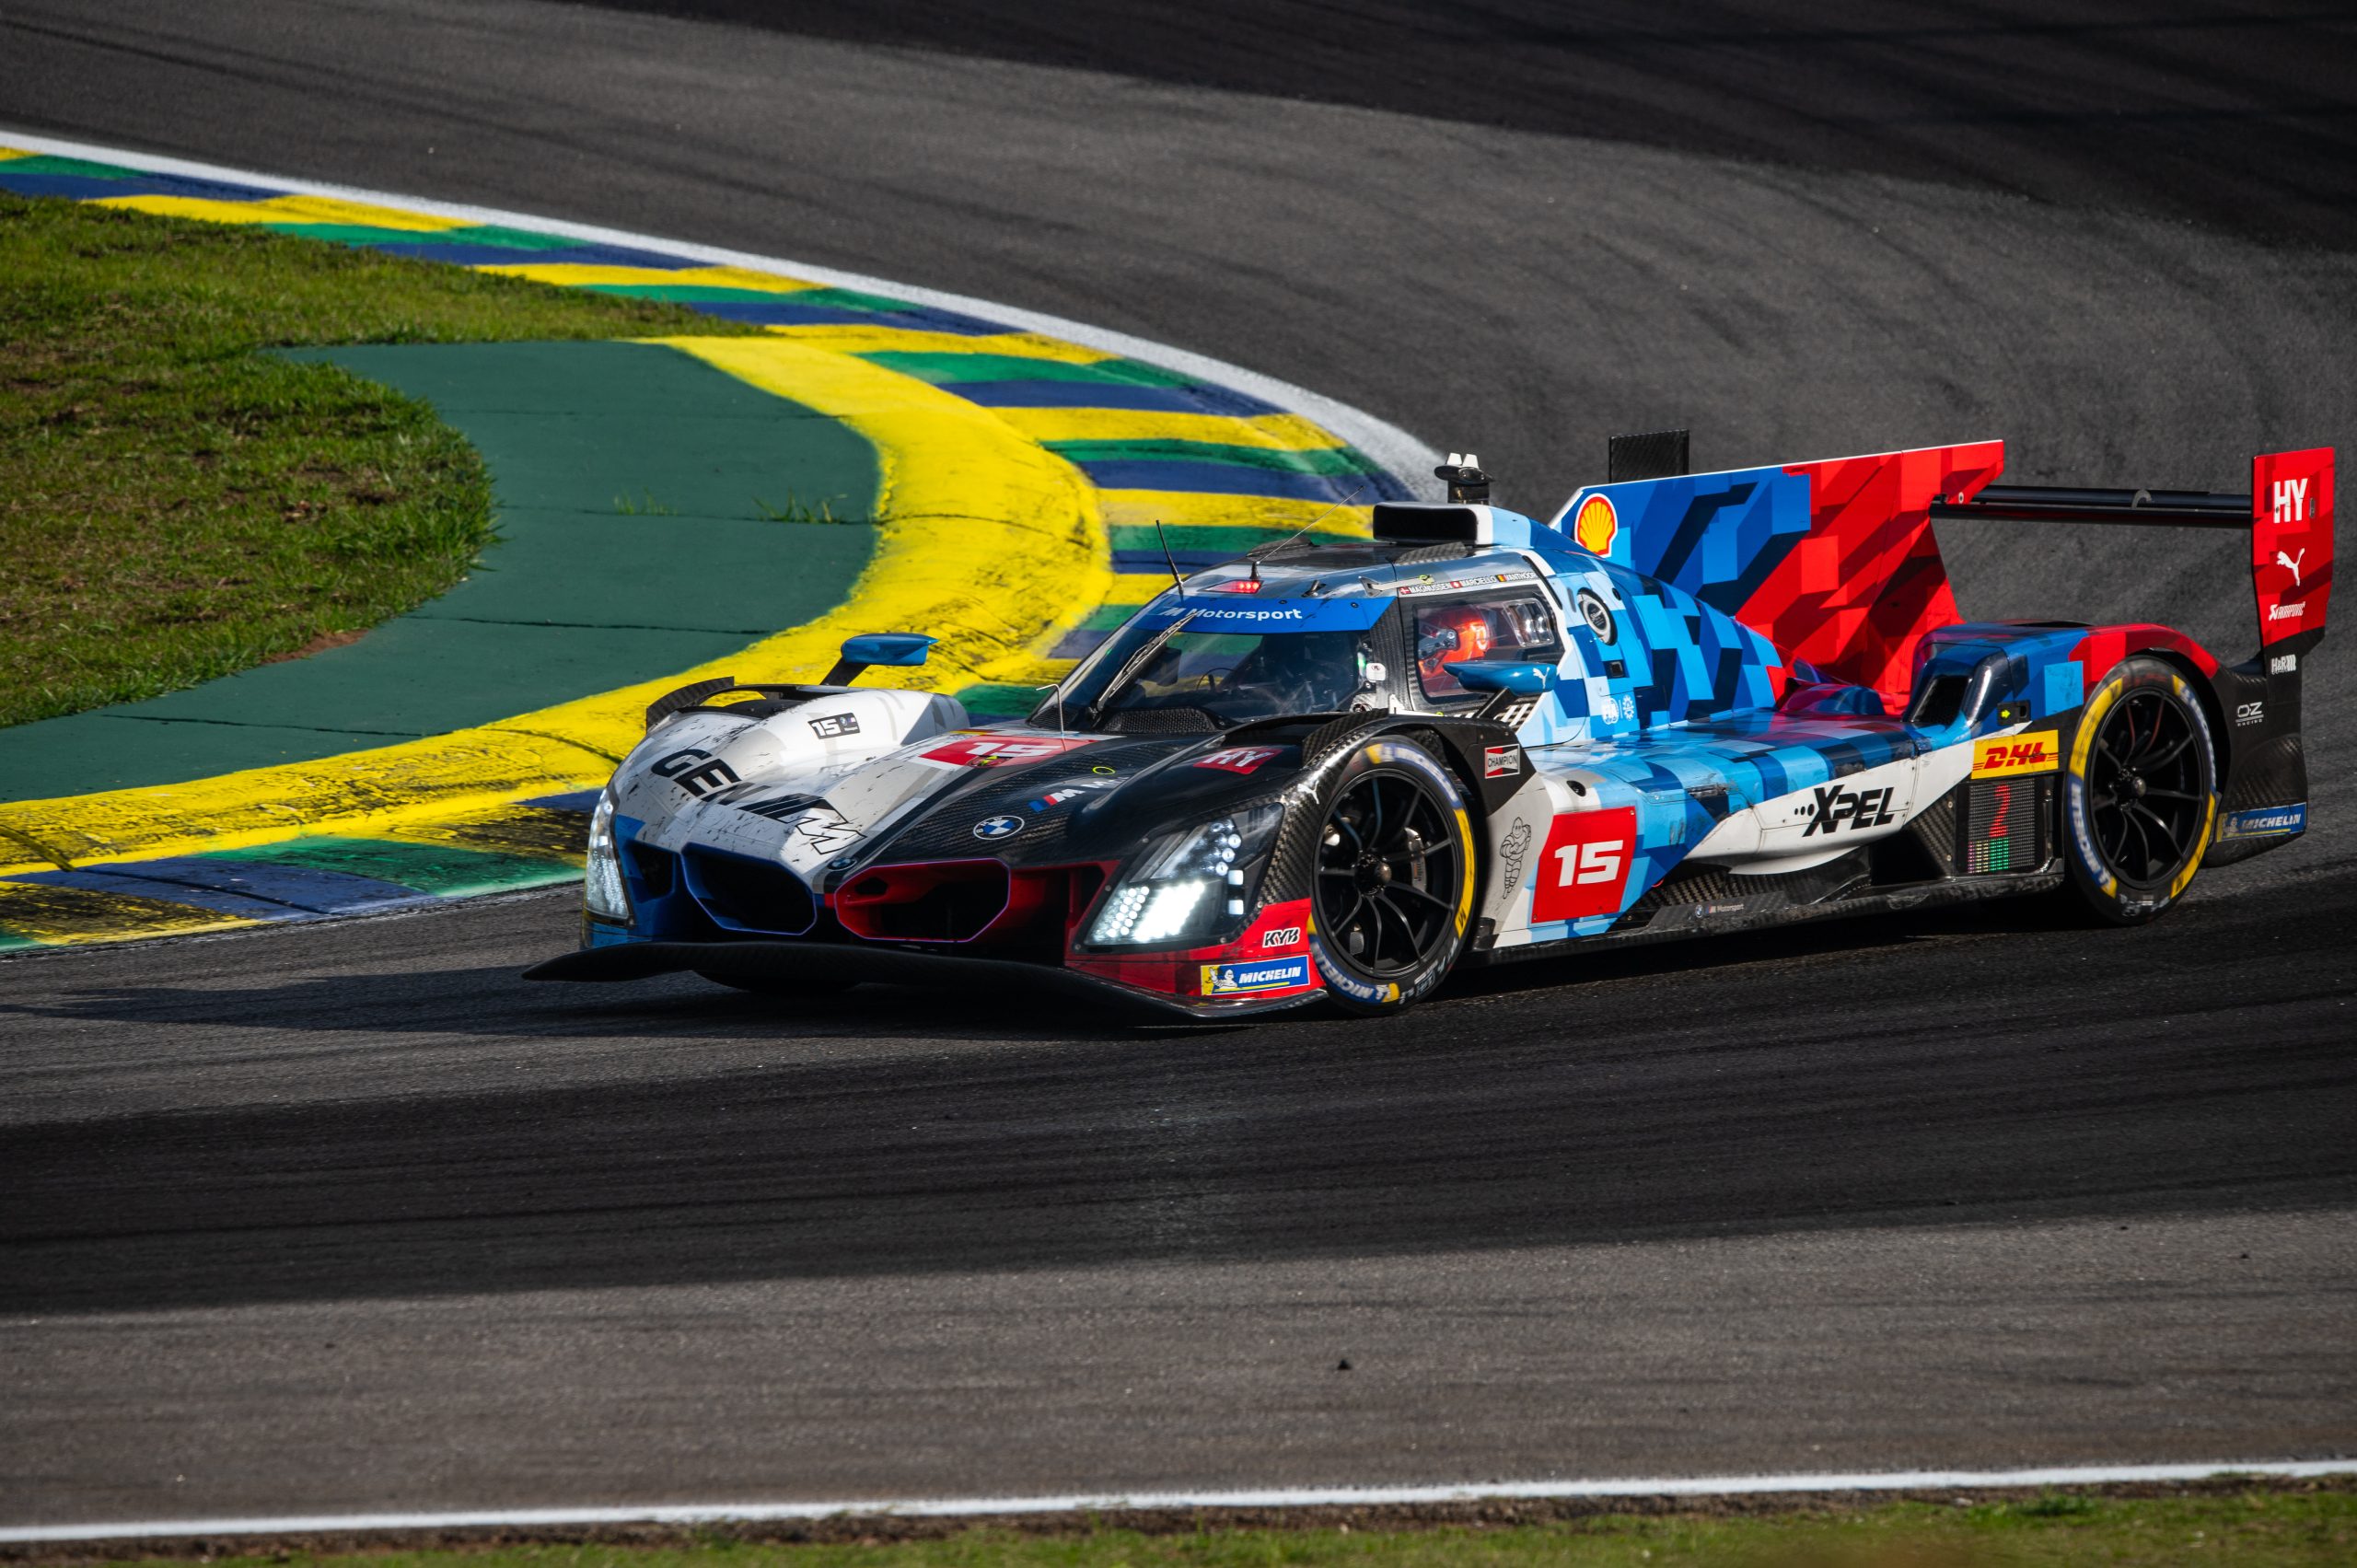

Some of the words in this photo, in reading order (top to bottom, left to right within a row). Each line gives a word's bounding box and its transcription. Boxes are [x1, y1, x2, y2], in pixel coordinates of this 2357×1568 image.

[2273, 478, 2308, 524] HY
[1409, 582, 1451, 594] MAGNUSSEN
[1459, 575, 1498, 588] MARCIELLO
[1185, 608, 1303, 621] Motorsport
[811, 718, 842, 736] 15
[965, 742, 1062, 757] 15
[1202, 750, 1274, 767] HY
[1983, 742, 2047, 770] DHL
[1488, 755, 1517, 767] CHAMPION
[1802, 784, 1896, 838] XPEL
[2242, 813, 2301, 830] MICHELIN
[1554, 840, 1623, 888] 15
[1263, 927, 1300, 947] KYB
[1238, 966, 1302, 984] MICHELIN
